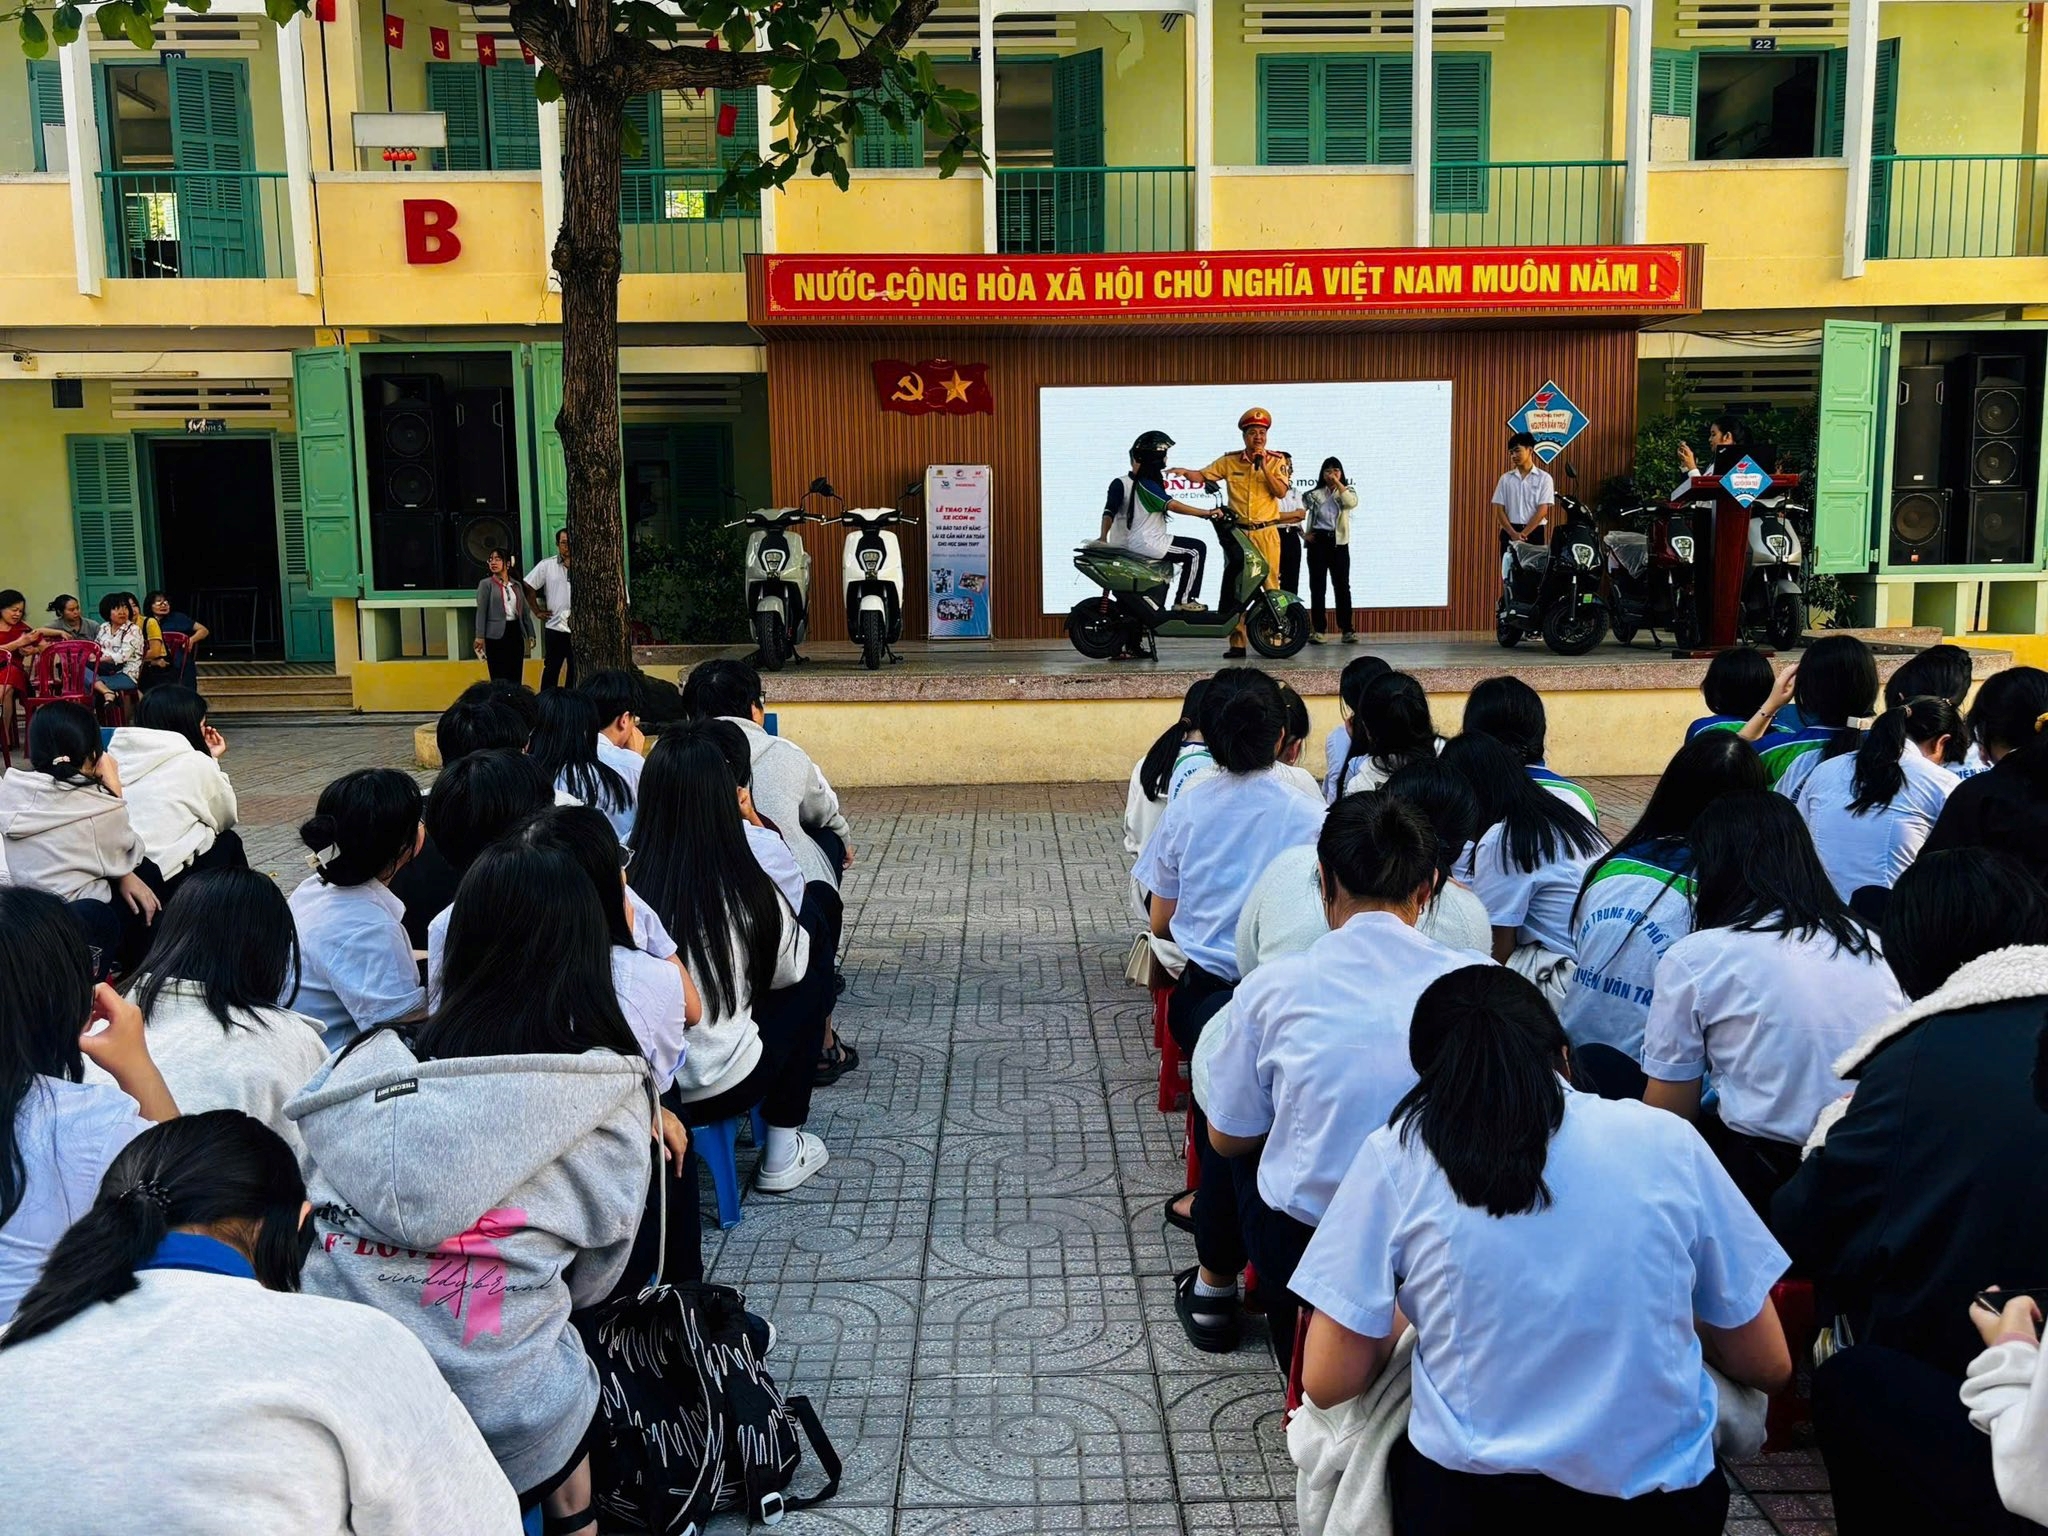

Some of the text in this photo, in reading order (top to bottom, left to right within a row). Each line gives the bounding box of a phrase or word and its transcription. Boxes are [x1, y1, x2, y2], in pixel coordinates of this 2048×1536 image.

[1755, 40, 1772, 49] 22
[402, 198, 462, 265] B
[794, 266, 876, 301] NƯỚC
[885, 266, 968, 307] CỘNG
[977, 265, 1037, 301] HÒA
[1045, 266, 1086, 301] XÃ
[1095, 265, 1143, 306] HỘI
[1153, 259, 1213, 299] CHỦ
[1222, 262, 1314, 297] NGHĨA
[1322, 260, 1385, 301] VIỆT
[1393, 265, 1462, 294] NAM
[1472, 258, 1561, 293] MUÔN
[1570, 258, 1638, 292] NĂM
[1591, 906, 1670, 945] TRUNG HỌC PHỔ
[1572, 966, 1655, 1007] UYỄN VĂN TR
